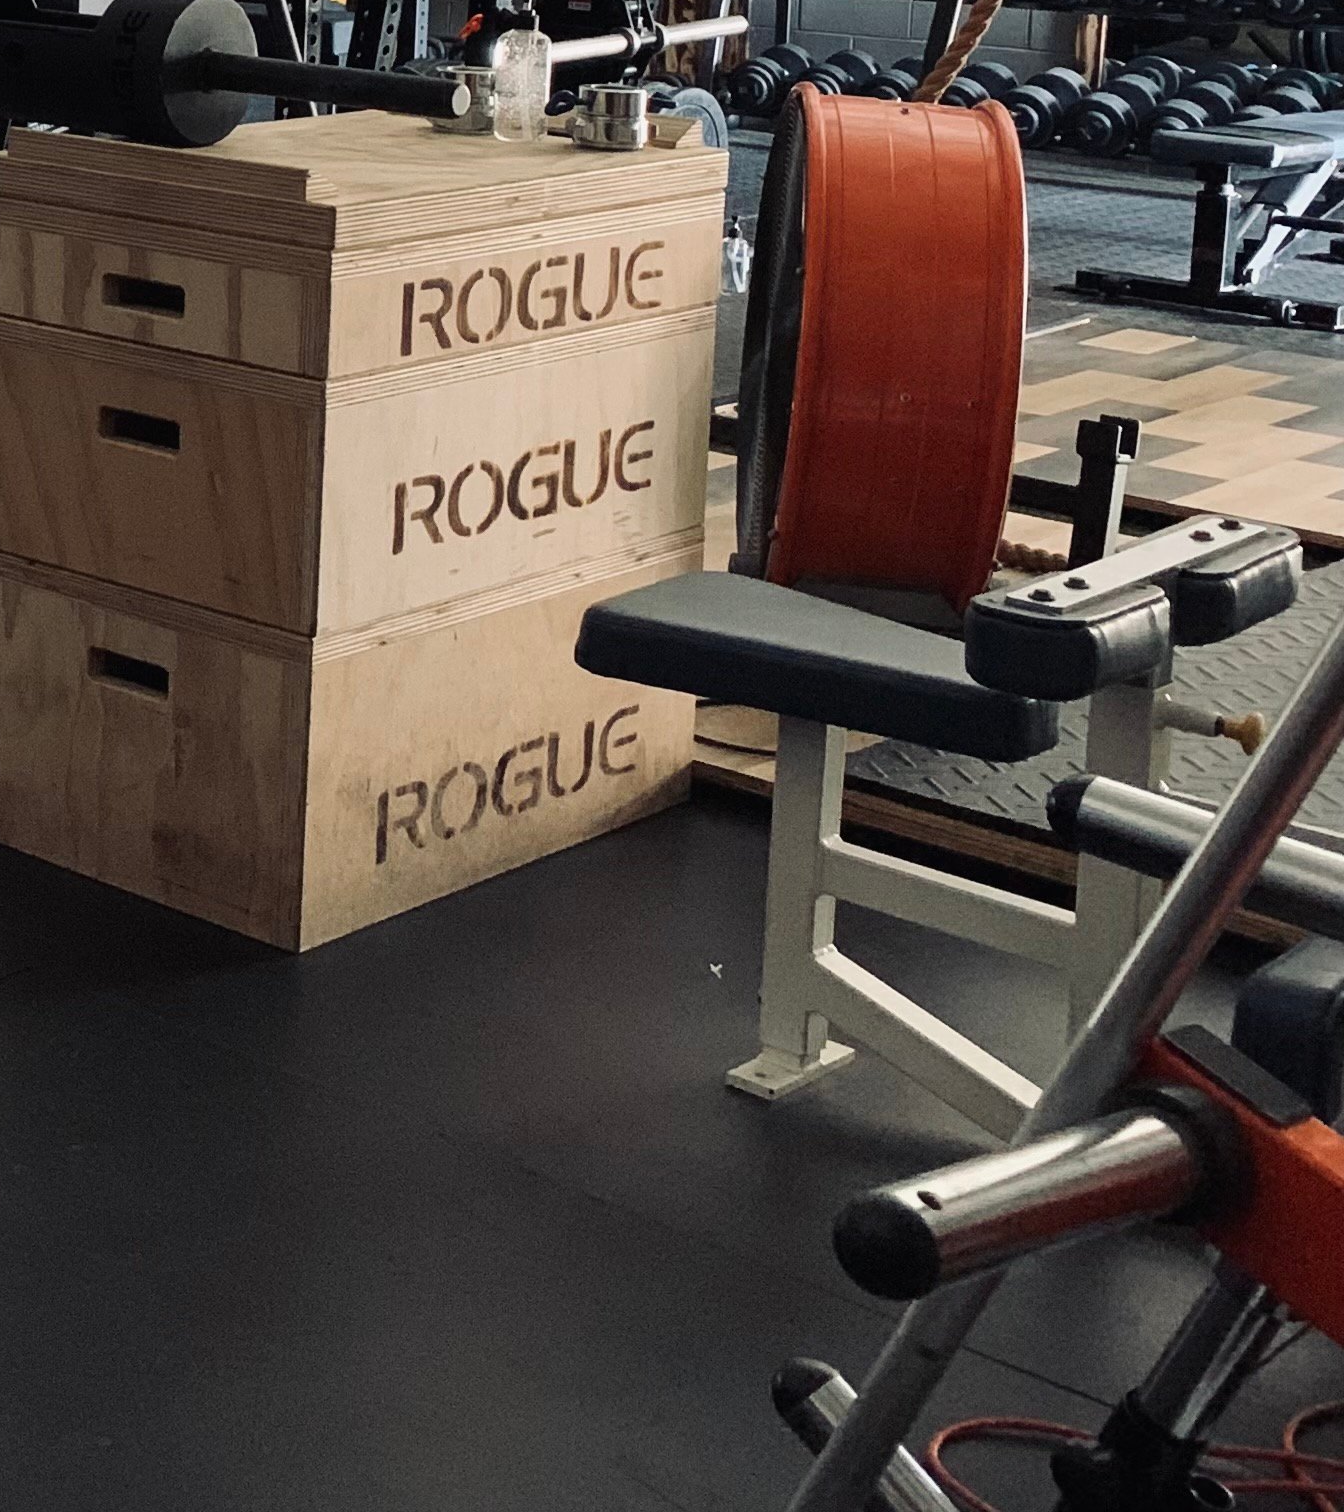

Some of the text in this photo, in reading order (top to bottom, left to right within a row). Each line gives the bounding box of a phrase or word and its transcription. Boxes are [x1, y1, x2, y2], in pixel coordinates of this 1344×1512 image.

[399, 240, 665, 358] ROGUE
[392, 419, 655, 556] ROGUE
[375, 704, 641, 865] ROGUE
